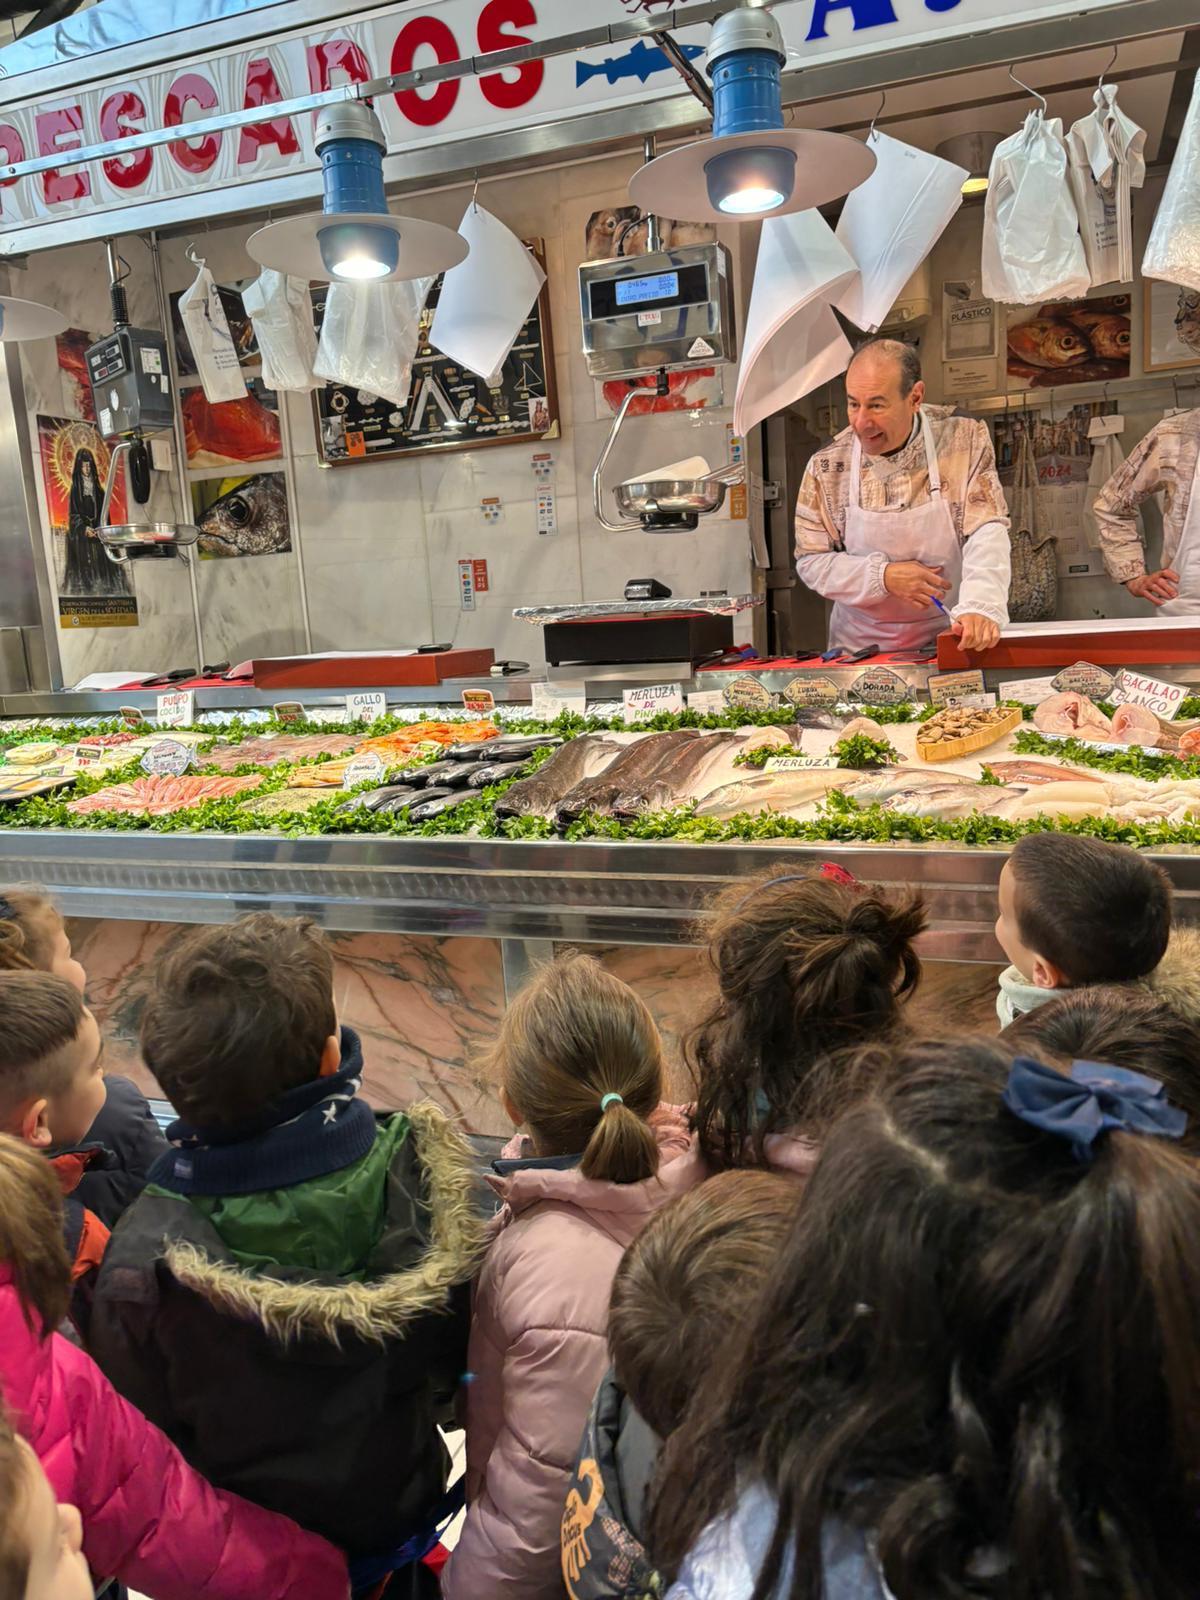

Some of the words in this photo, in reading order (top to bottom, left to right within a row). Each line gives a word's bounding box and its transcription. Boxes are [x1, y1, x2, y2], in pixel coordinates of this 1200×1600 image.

[1040, 465, 1072, 479] 2024
[629, 685, 676, 700] MERLUZA
[863, 682, 895, 693] DORADA
[1121, 675, 1181, 701] BACALAO
[163, 693, 189, 707] PULPO
[353, 694, 381, 706] GALLO
[643, 701, 656, 709] DE
[772, 758, 830, 767] MERLUZA
